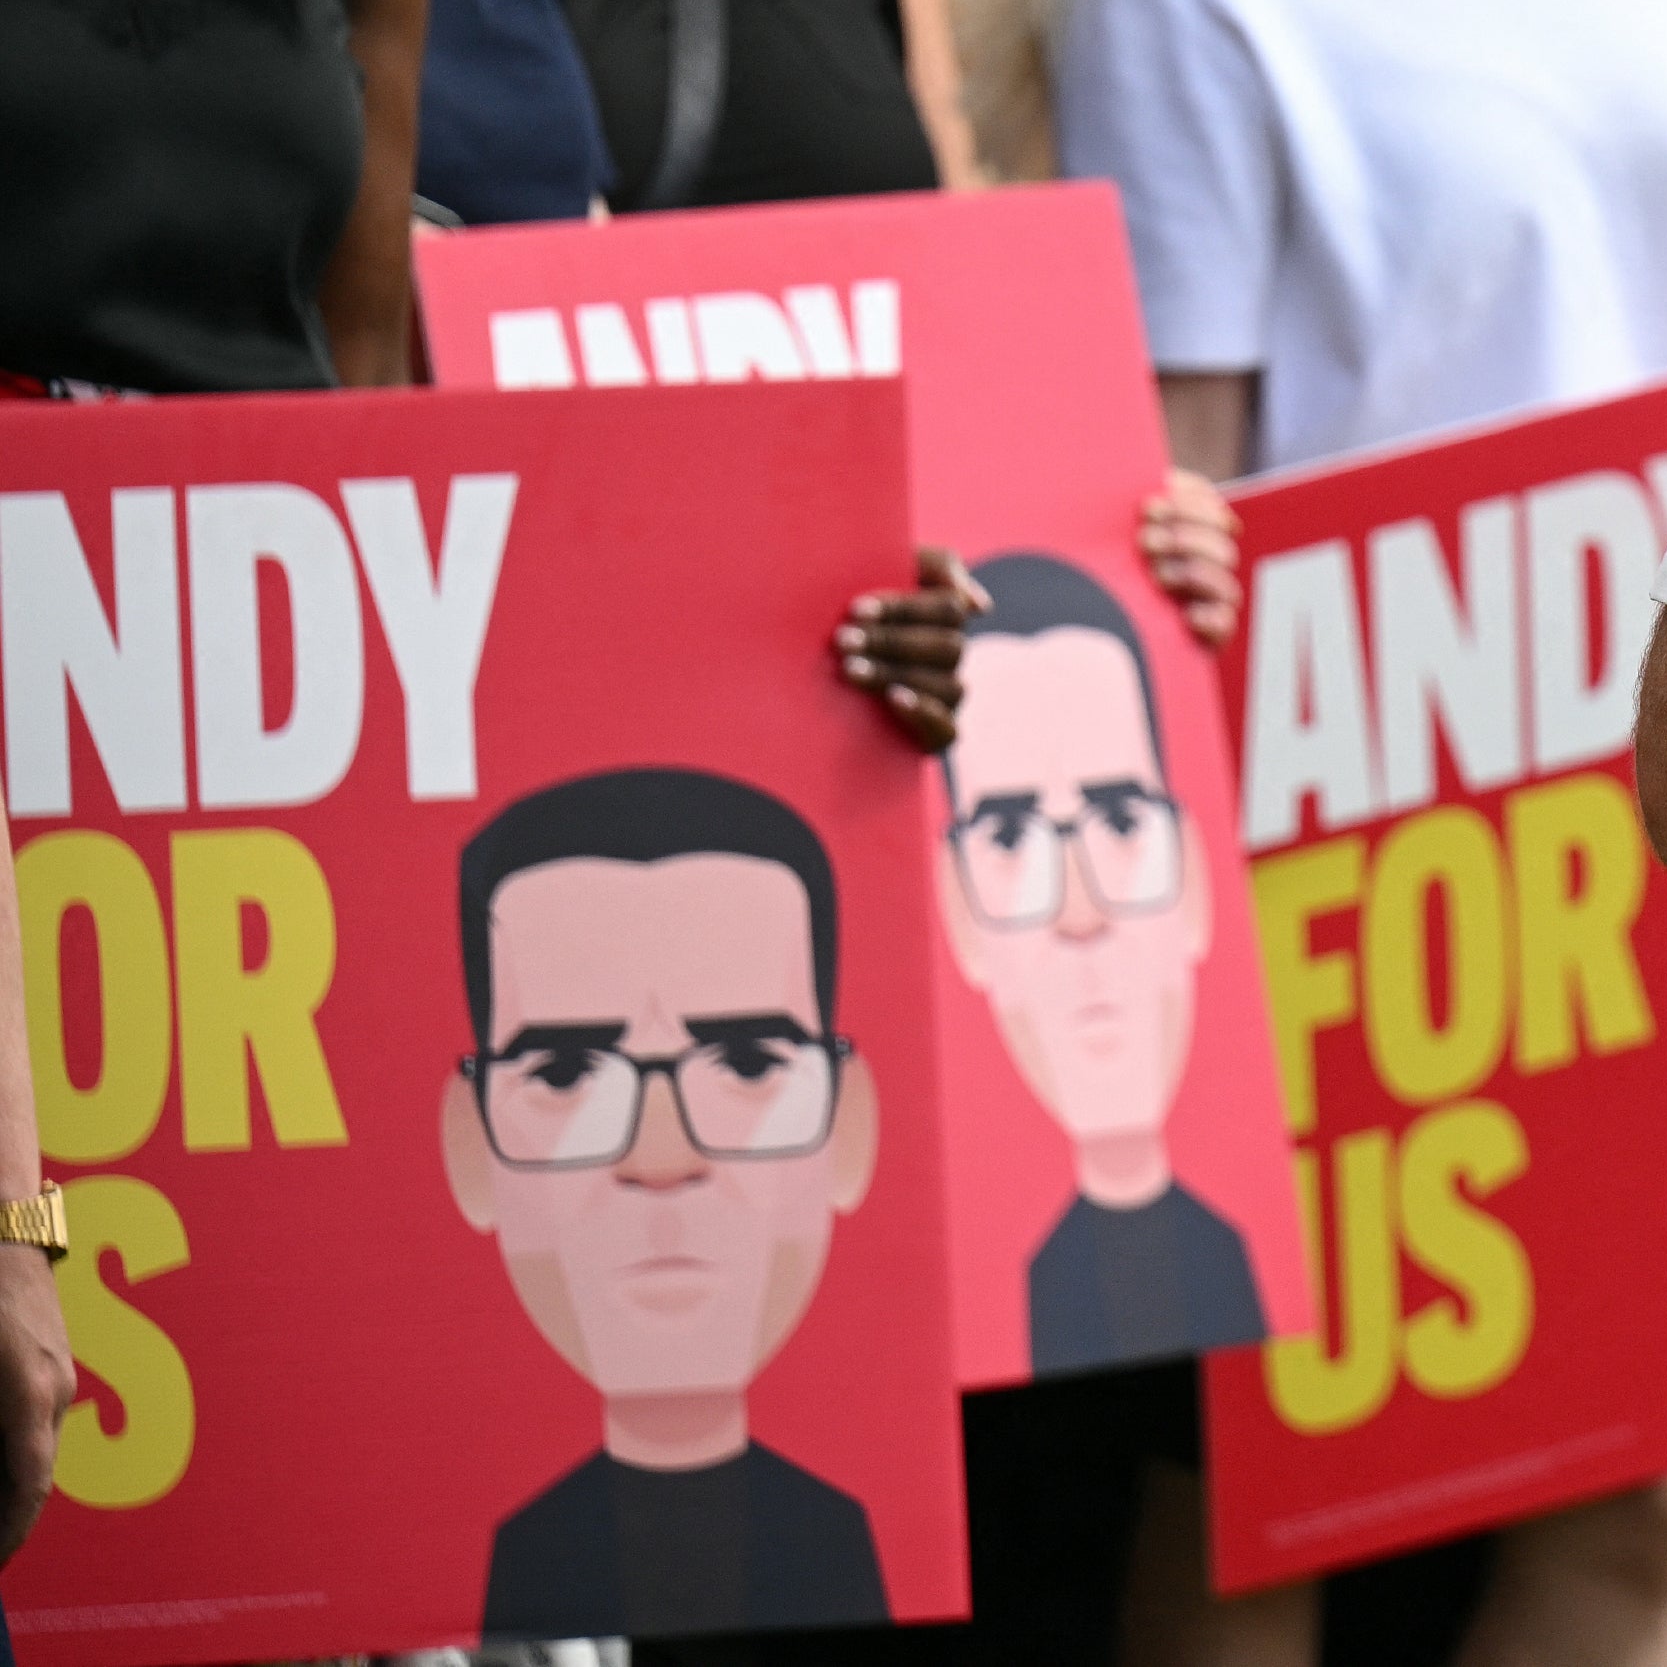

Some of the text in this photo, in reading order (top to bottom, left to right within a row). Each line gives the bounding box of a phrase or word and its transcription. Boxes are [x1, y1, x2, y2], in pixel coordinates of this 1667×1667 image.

[0, 472, 520, 819] NDY
[12, 826, 349, 1166] OR
[1250, 772, 1655, 1138] FOR
